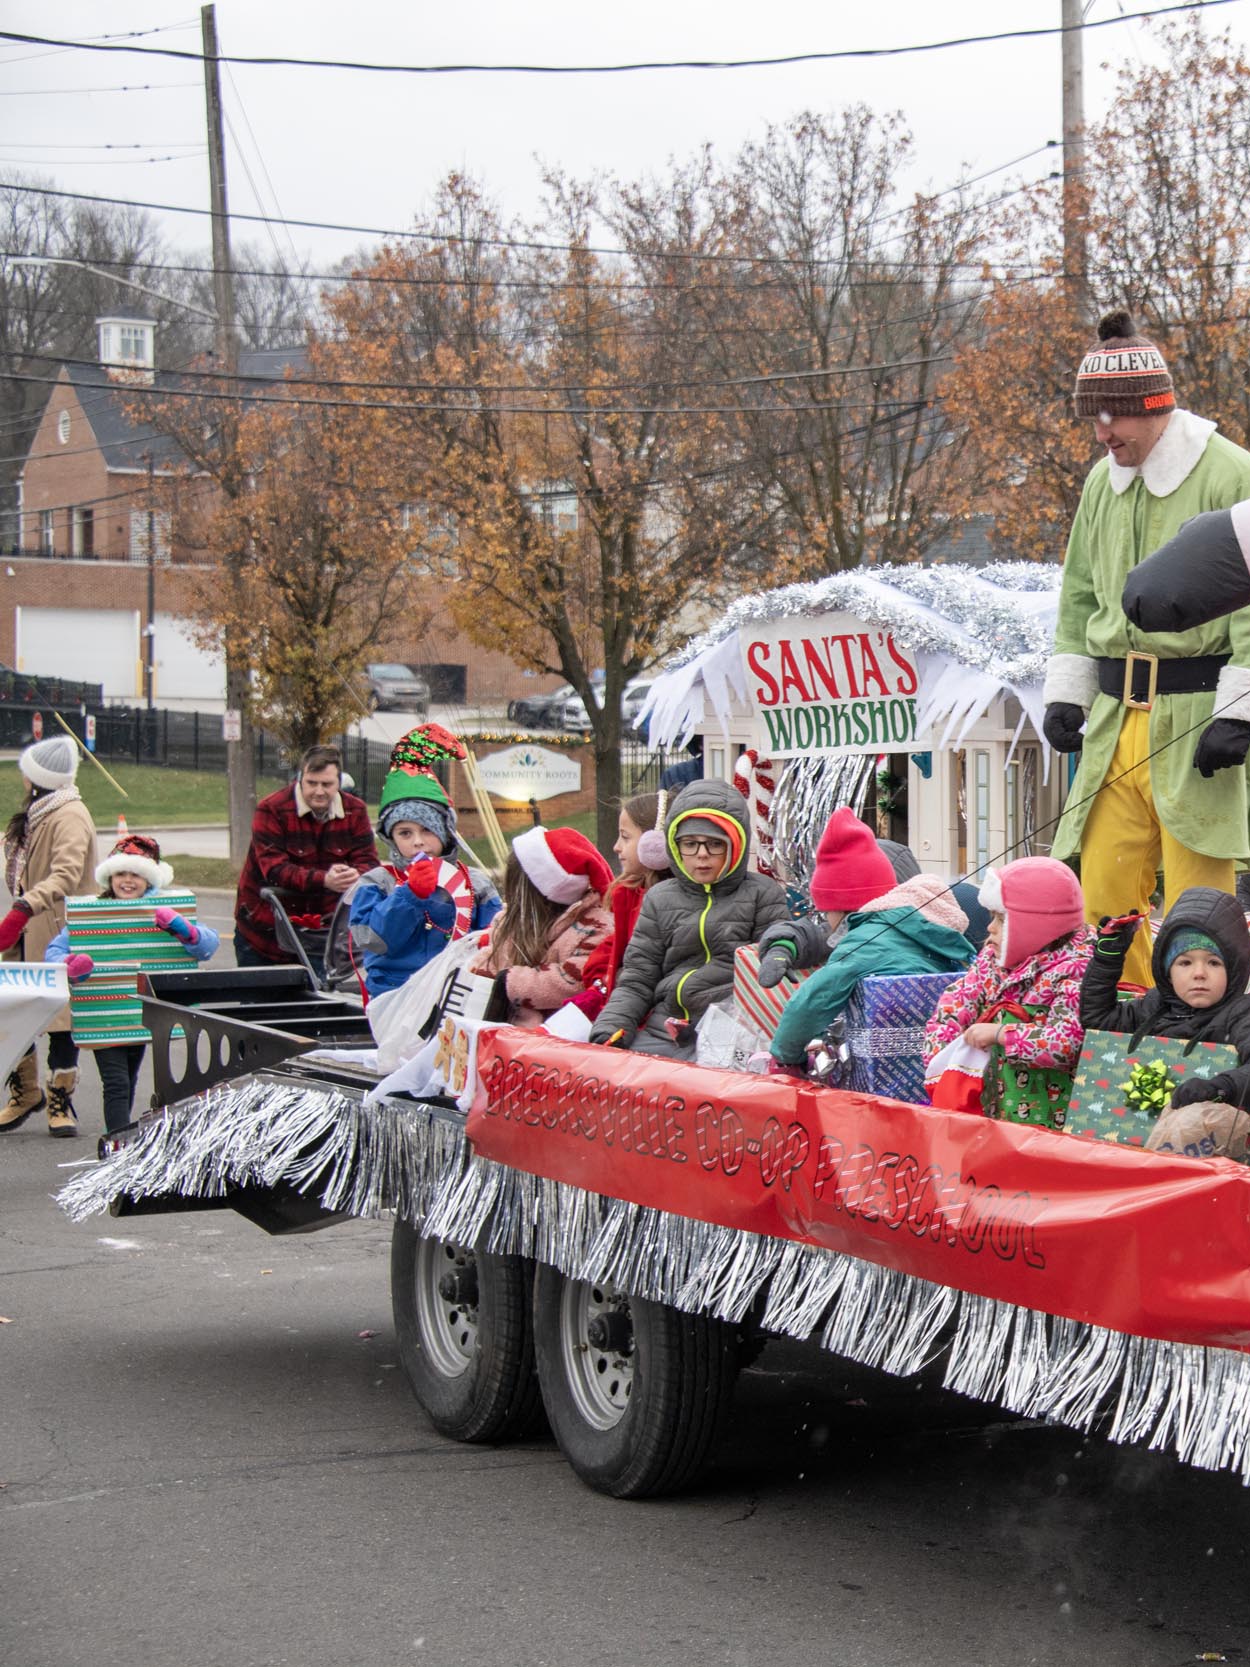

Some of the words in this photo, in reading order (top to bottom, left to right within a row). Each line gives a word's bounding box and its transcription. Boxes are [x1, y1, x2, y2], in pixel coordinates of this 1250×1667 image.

[748, 632, 918, 706] SANTA'S
[486, 1055, 687, 1163] BRECKSVILLE
[695, 1101, 810, 1191] CO-OP
[813, 1135, 1049, 1269] PRESCHOOL
